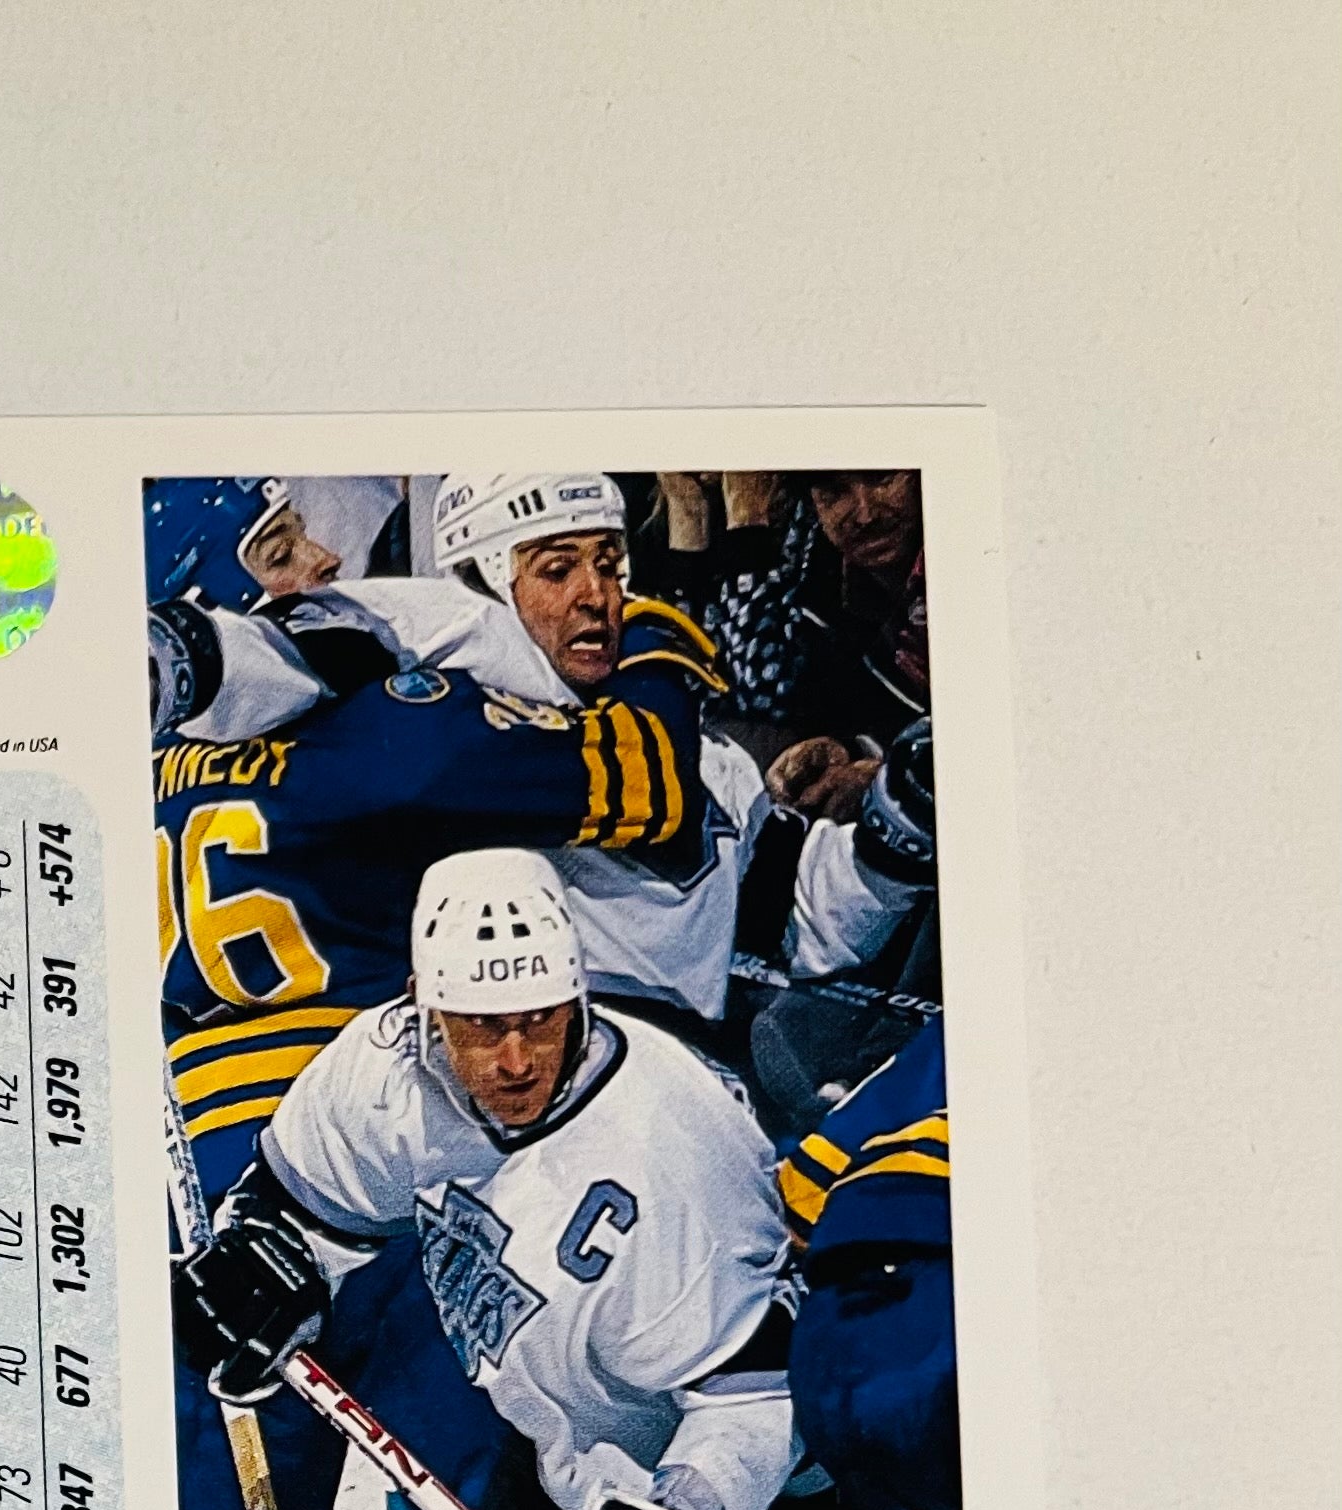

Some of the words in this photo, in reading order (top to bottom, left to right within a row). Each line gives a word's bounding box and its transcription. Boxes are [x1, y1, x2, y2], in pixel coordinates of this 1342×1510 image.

[13, 741, 25, 752] in
[29, 737, 59, 752] USA
[39, 823, 73, 906] +574
[43, 957, 77, 1016] 391
[469, 954, 549, 982] JOFA
[46, 1058, 85, 1146] 1,979
[51, 1204, 90, 1293] 1,302
[556, 1178, 638, 1283] C
[55, 1345, 90, 1407] 677
[295, 1351, 431, 1489] TAN
